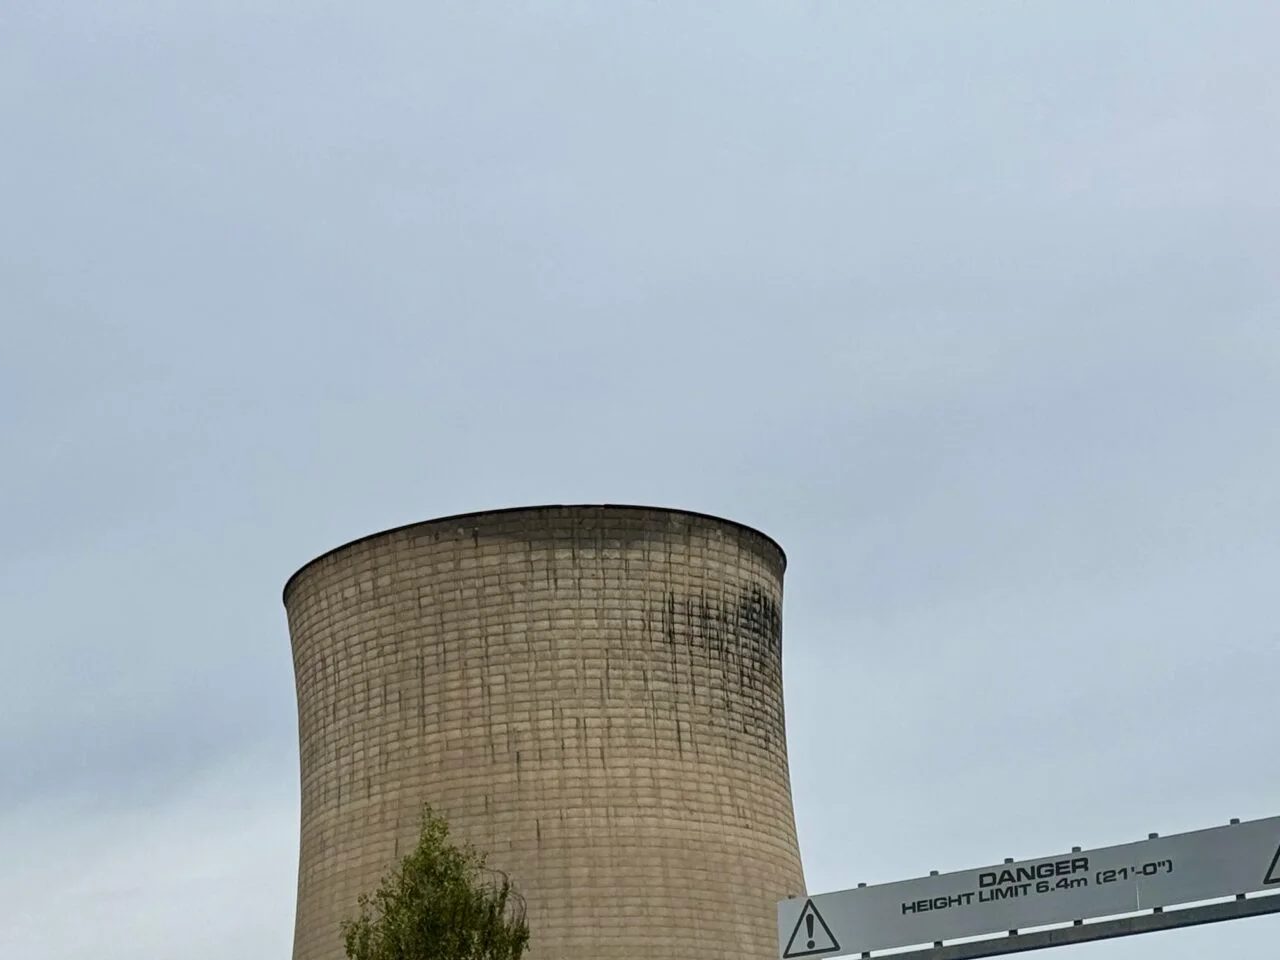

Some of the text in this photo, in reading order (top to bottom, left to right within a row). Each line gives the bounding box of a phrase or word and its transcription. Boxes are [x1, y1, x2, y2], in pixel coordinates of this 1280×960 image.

[902, 859, 1173, 915] HEIGHT LIMIT 6.4m (21'-0")
[979, 857, 1089, 888] DANGER
